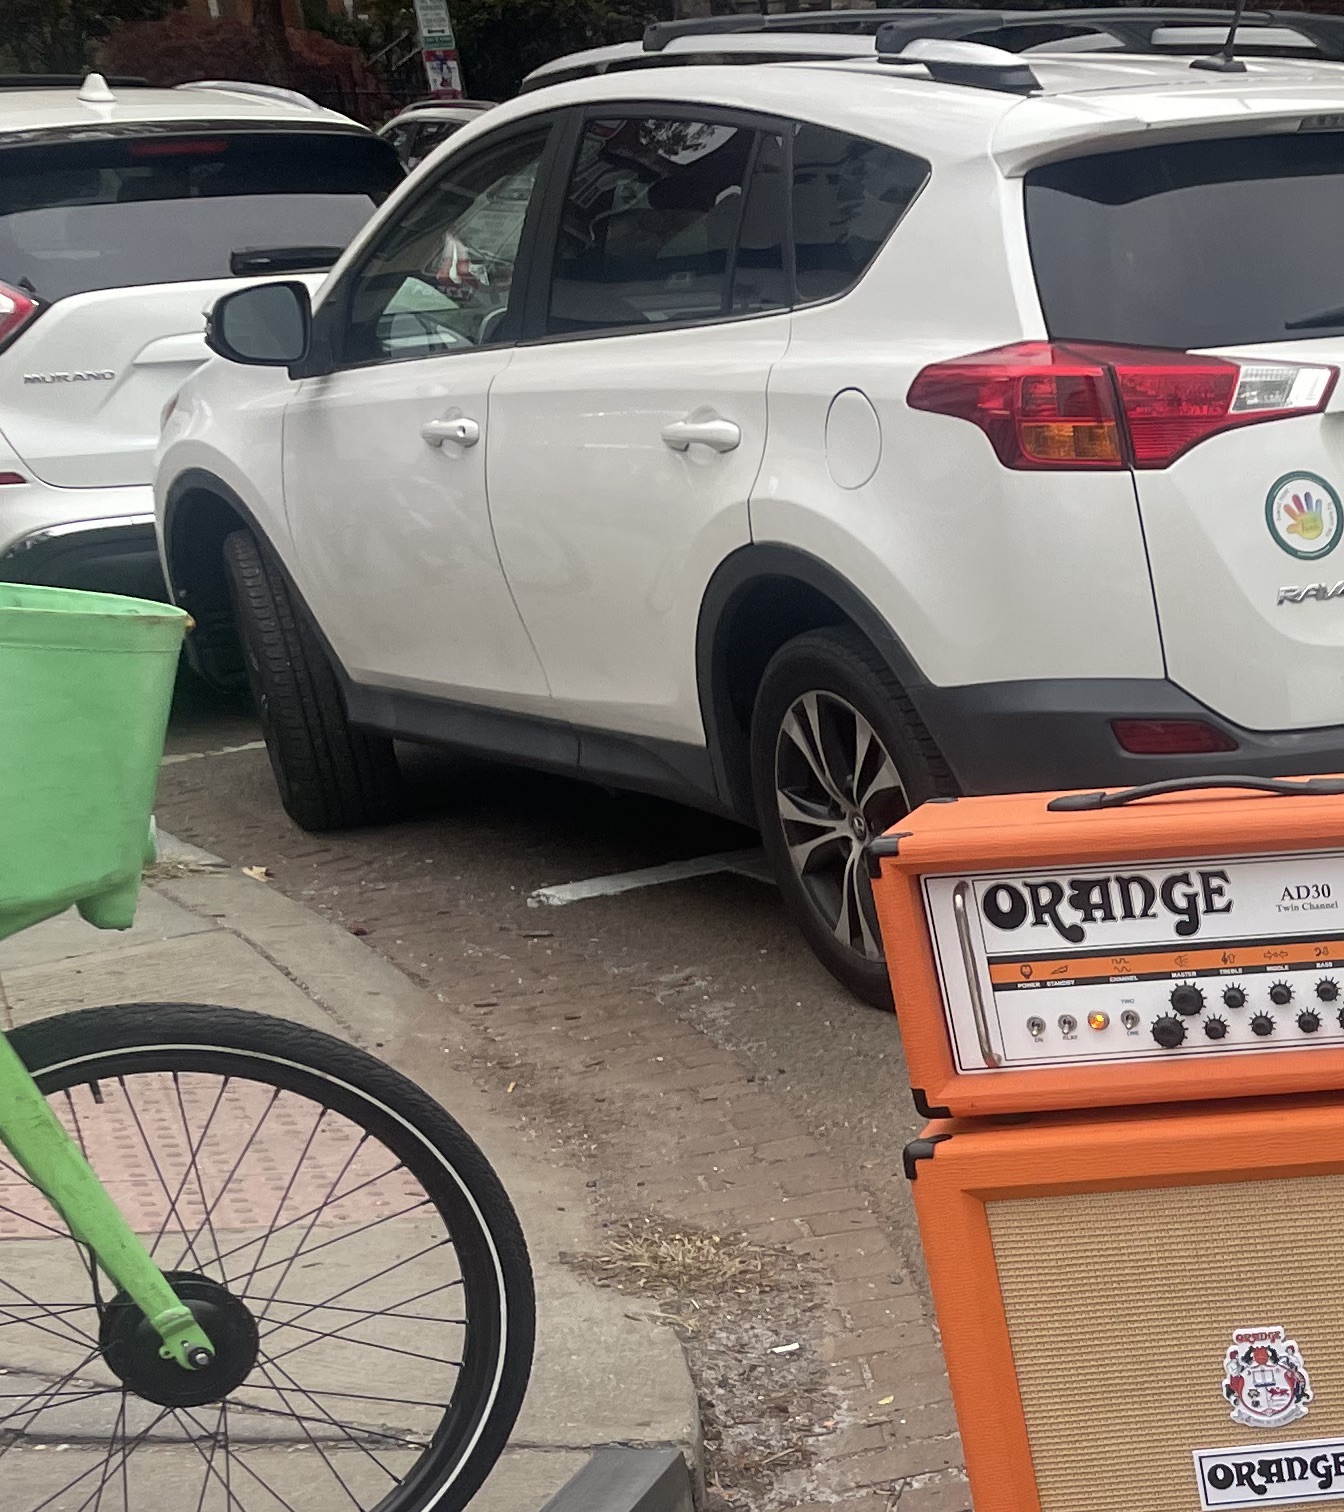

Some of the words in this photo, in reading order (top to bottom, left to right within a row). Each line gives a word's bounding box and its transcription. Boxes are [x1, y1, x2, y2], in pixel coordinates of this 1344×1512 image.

[23, 369, 115, 385] MURANO
[1281, 884, 1331, 901] AD30
[983, 870, 1234, 943] ORANGE
[1276, 903, 1299, 913] Twin
[1302, 901, 1338, 911] Channel
[1171, 970, 1196, 978] MASTER
[1266, 964, 1289, 972] MIDDLE
[1316, 961, 1333, 969] BASS
[1236, 1331, 1281, 1344] ORANGE
